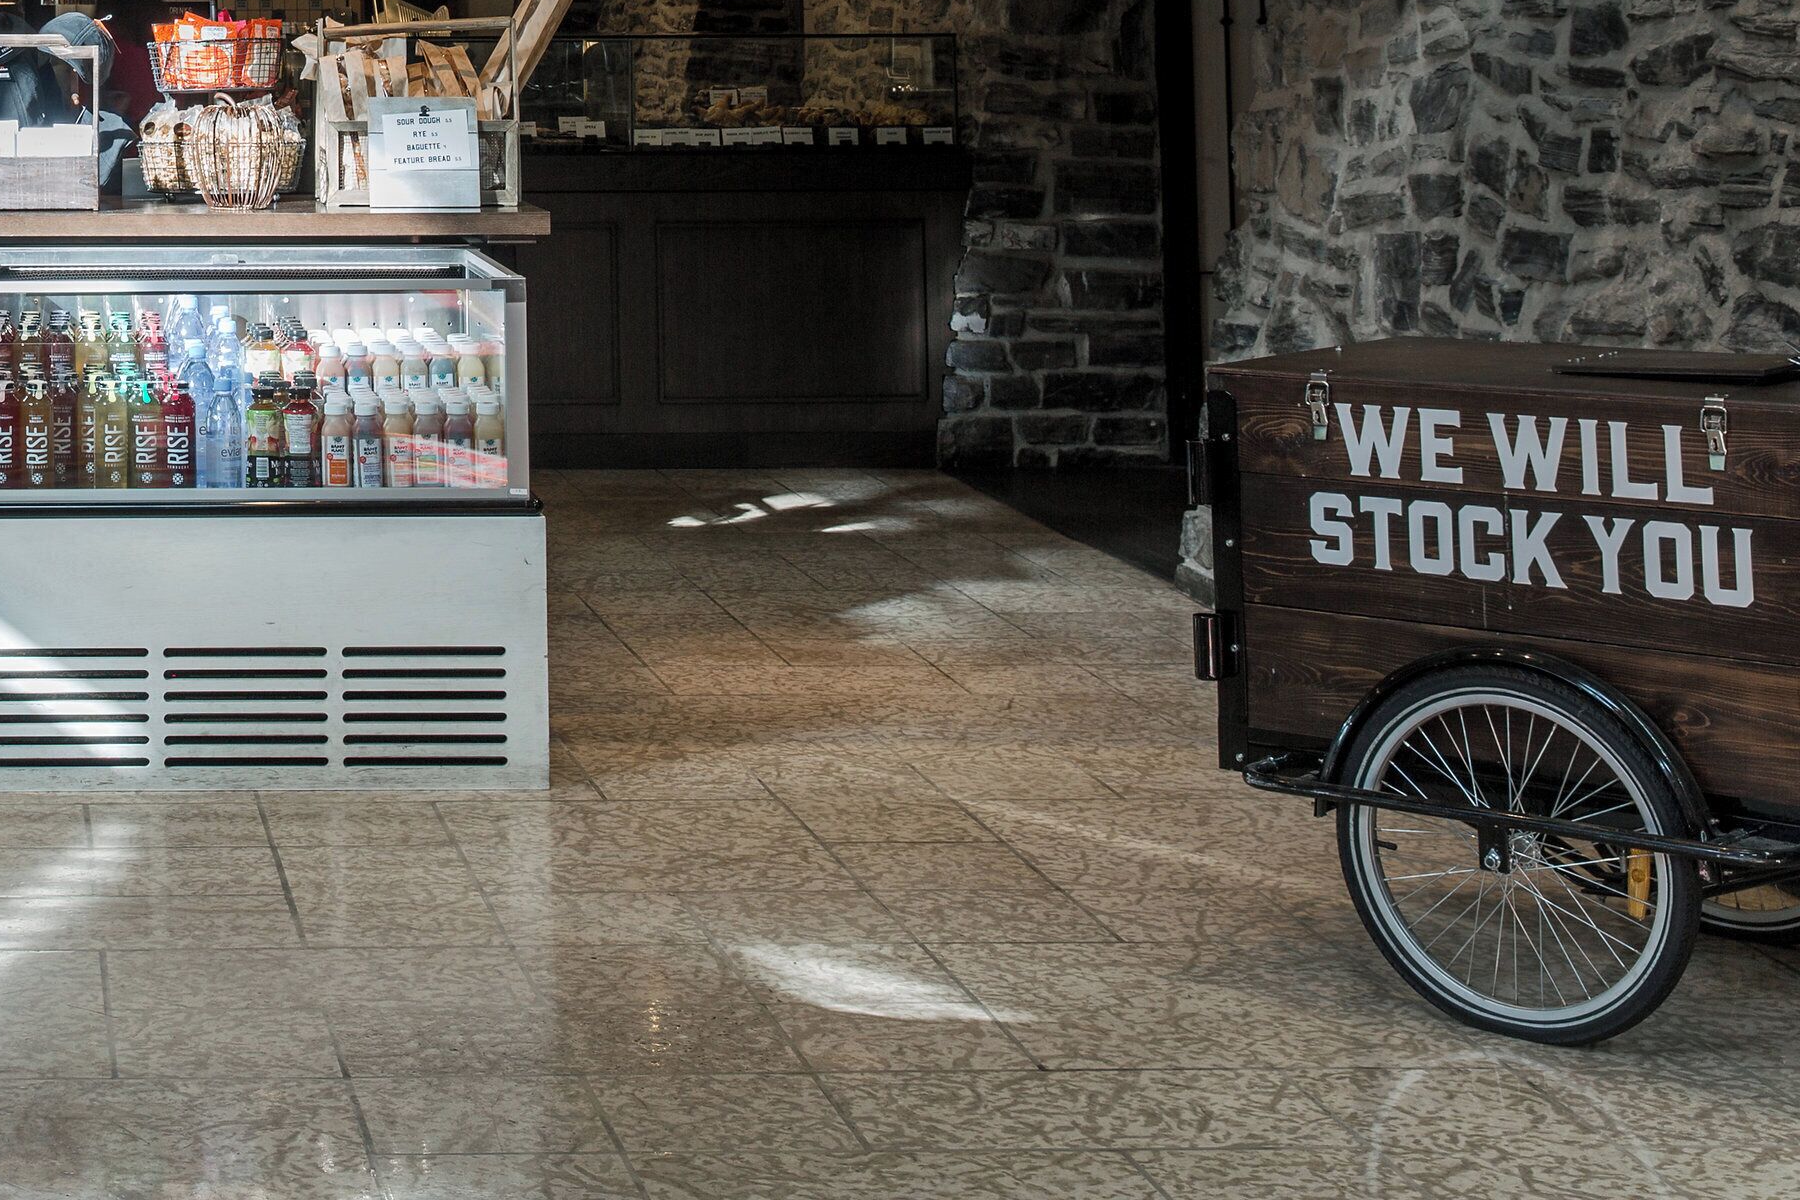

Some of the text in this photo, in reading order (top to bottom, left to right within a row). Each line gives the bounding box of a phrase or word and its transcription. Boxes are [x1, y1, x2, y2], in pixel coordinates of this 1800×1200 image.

[396, 118, 415, 126] SOUR
[418, 116, 441, 124] DOUGH
[412, 130, 427, 138] RYE
[394, 156, 425, 165] FEATURE
[406, 143, 441, 151] BAGUETTE
[25, 425, 49, 465] RISE
[53, 416, 72, 455] RISE
[104, 424, 127, 463] RISE
[135, 425, 158, 465] RISE
[166, 425, 190, 466] RISE
[1334, 402, 1715, 505] WE WILL
[1309, 491, 1755, 609] STOCK YOU
